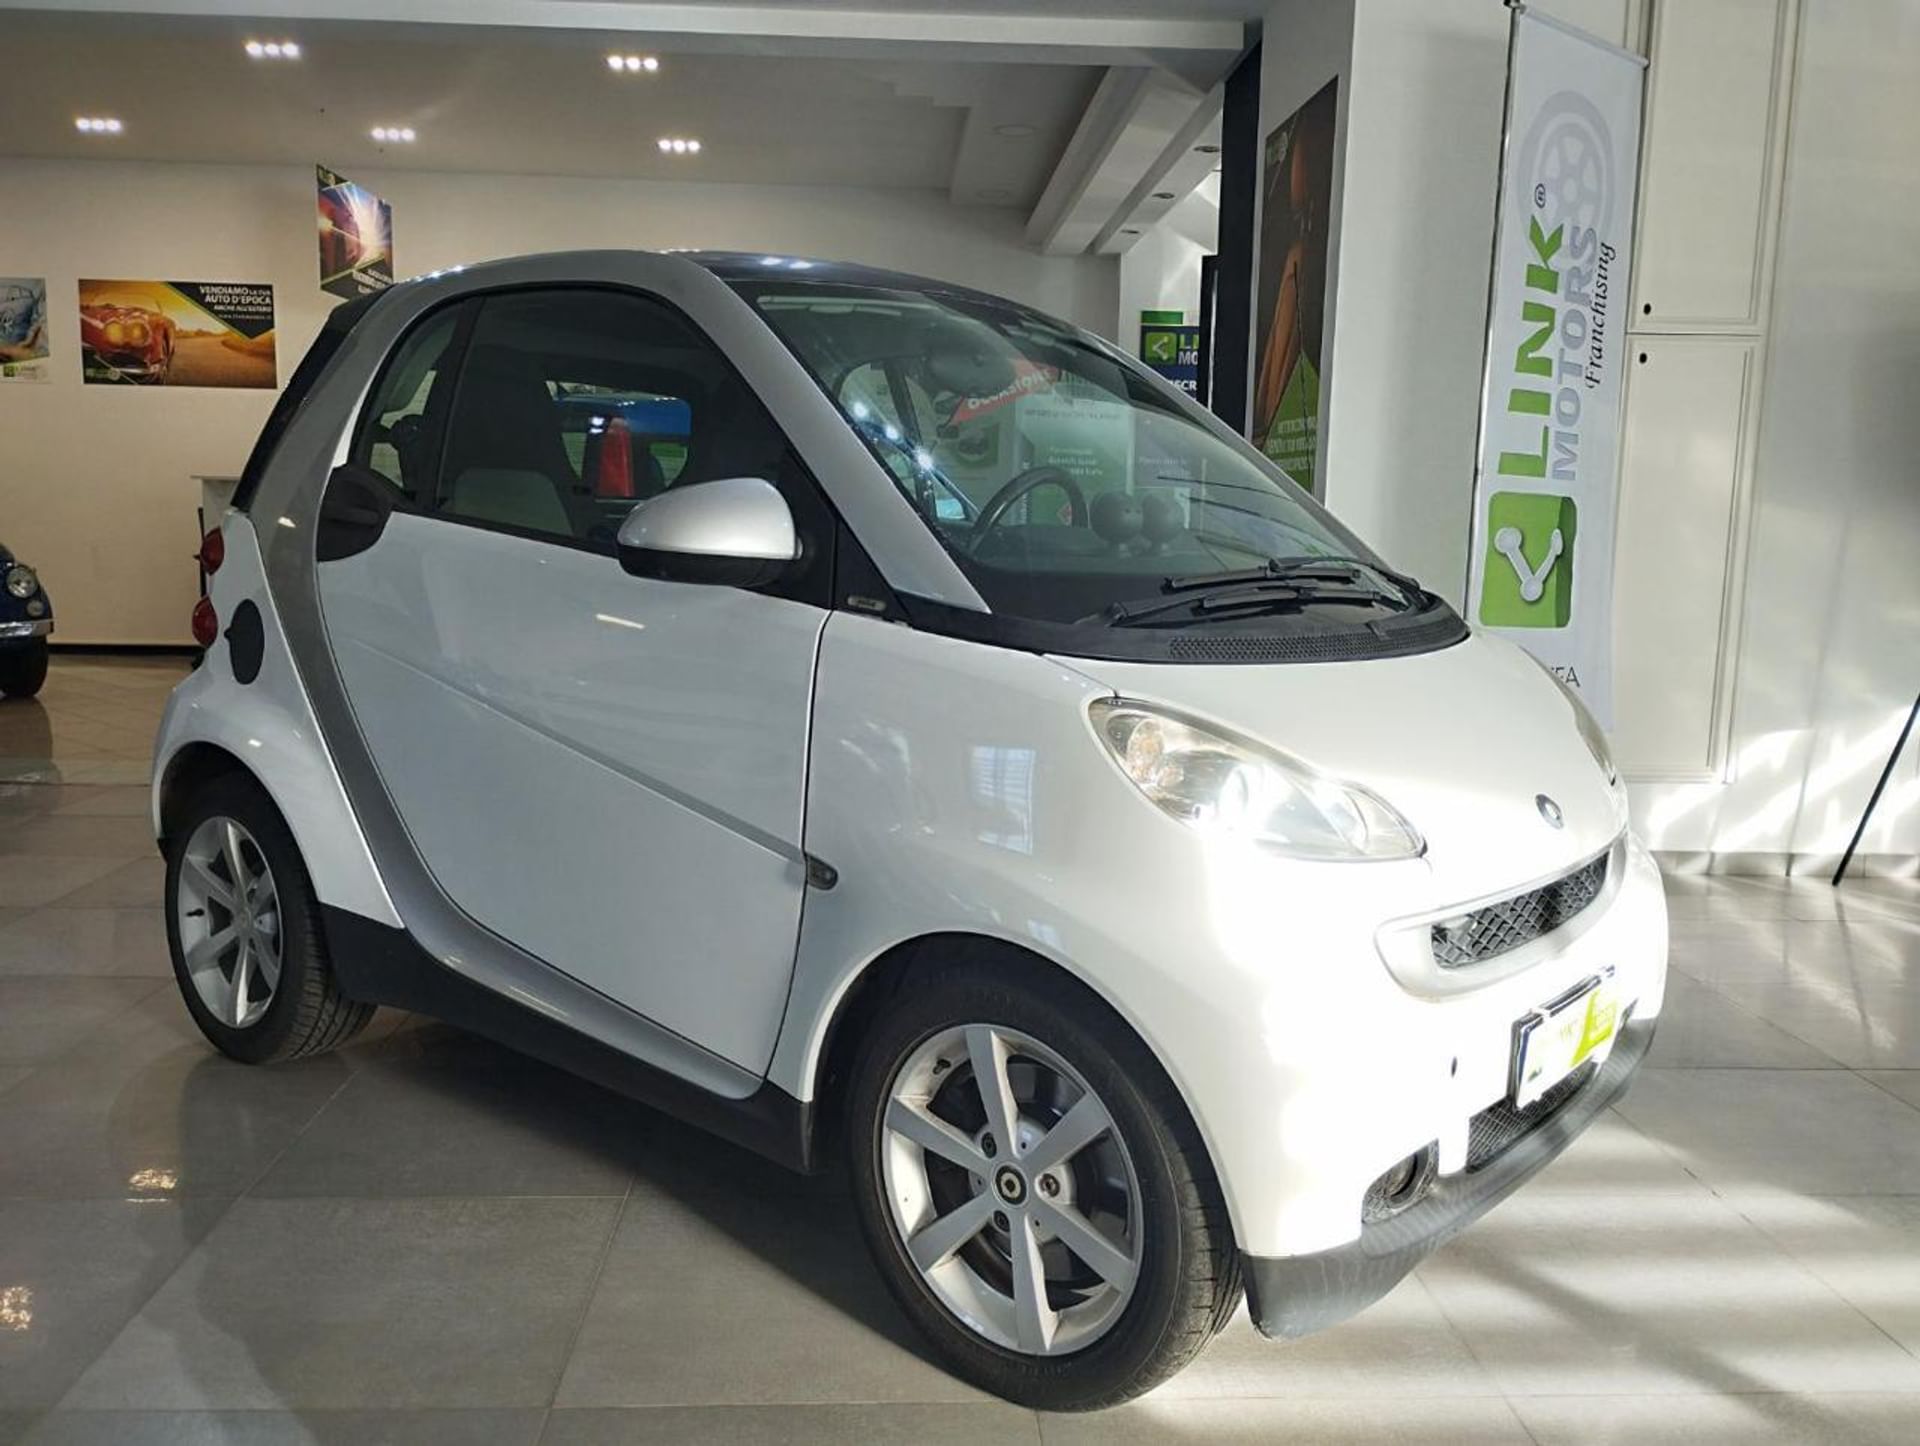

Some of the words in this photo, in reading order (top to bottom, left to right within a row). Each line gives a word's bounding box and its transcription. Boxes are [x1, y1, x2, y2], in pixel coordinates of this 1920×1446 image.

[200, 286, 249, 295] VENDIAMO
[205, 295, 231, 303] AUTO
[231, 296, 272, 304] D'EPOCA
[1585, 242, 1616, 389] Franchising
[1552, 225, 1597, 481] MOTORS
